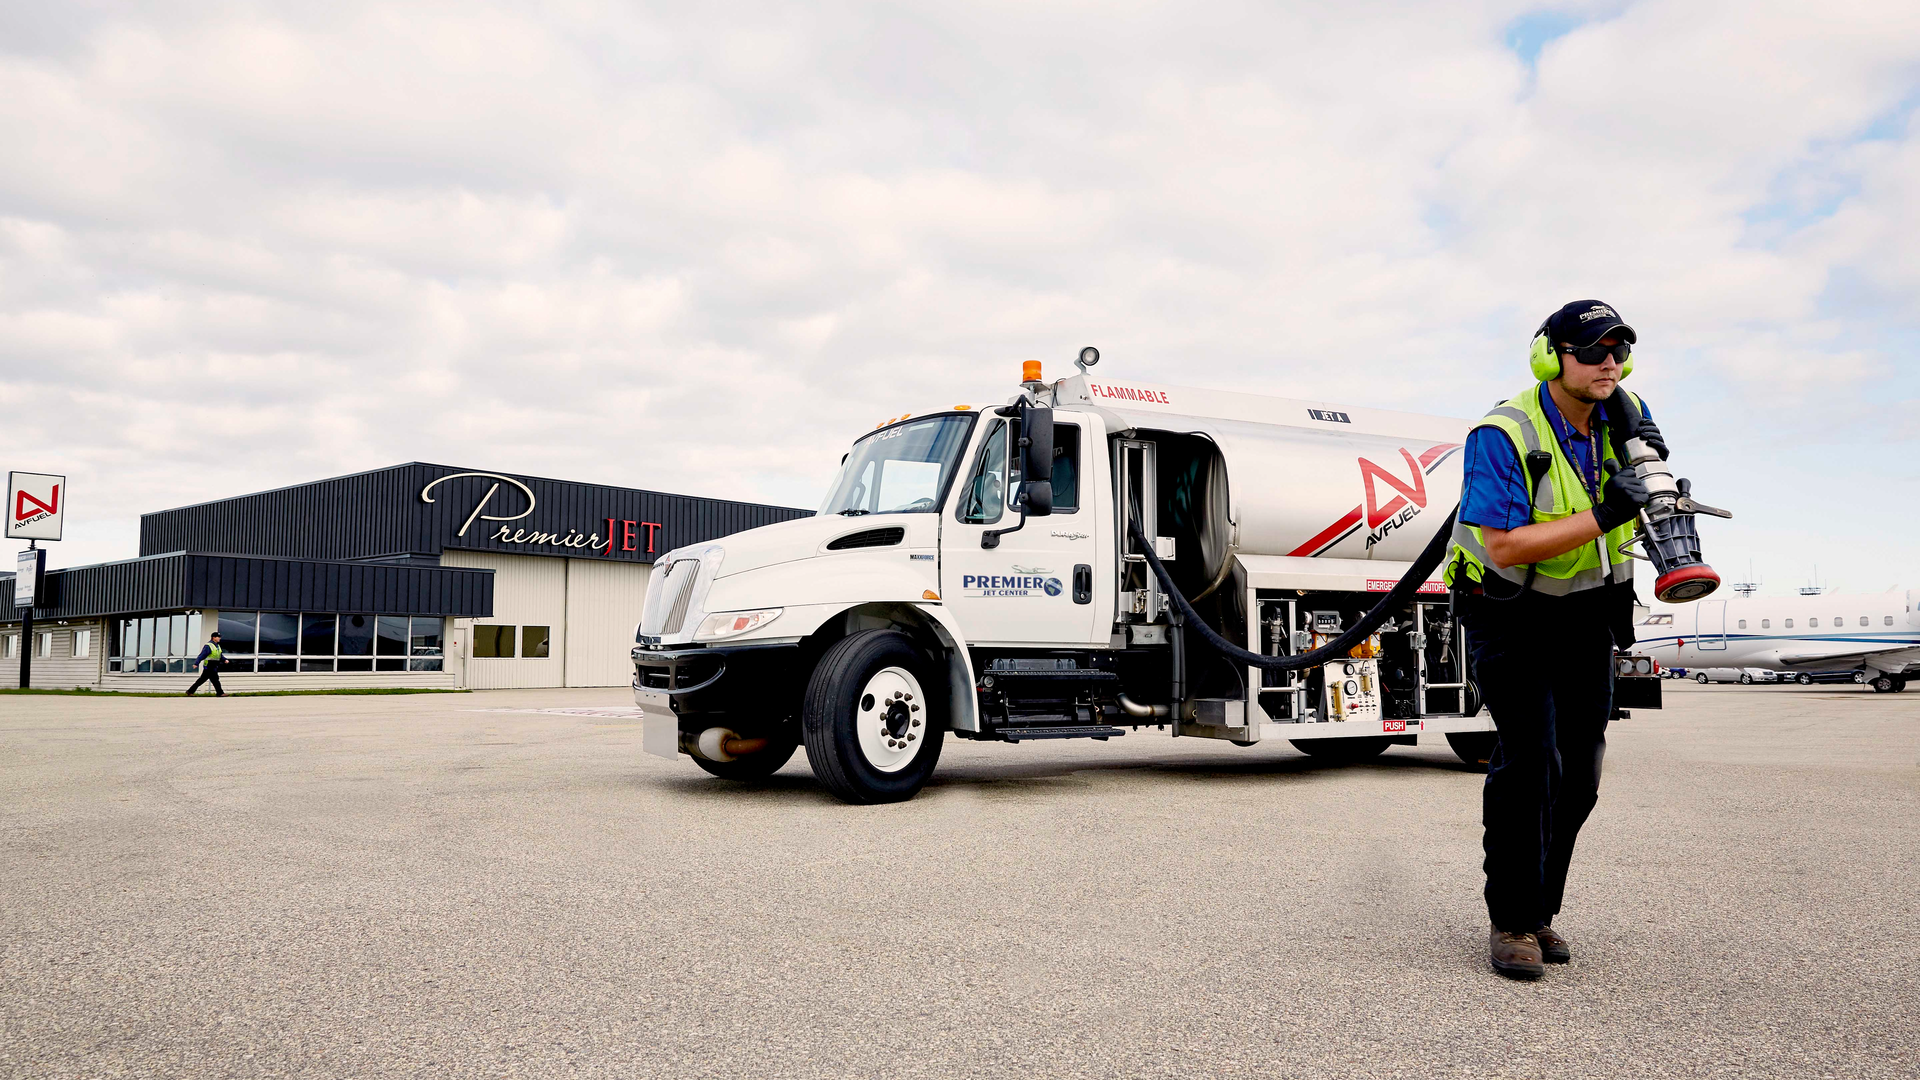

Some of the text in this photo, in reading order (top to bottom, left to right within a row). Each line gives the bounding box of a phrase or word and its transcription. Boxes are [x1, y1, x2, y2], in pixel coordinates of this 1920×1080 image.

[1090, 384, 1170, 404] FLAMMABLE
[1320, 411, 1345, 422] JET A
[864, 426, 904, 447] AVFUEL
[14, 512, 51, 530] AVFUEL
[421, 472, 662, 556] Premier JET
[1365, 505, 1421, 551] AVFUEL
[963, 575, 1043, 589] PREMIER
[1384, 721, 1404, 731] PUSH
